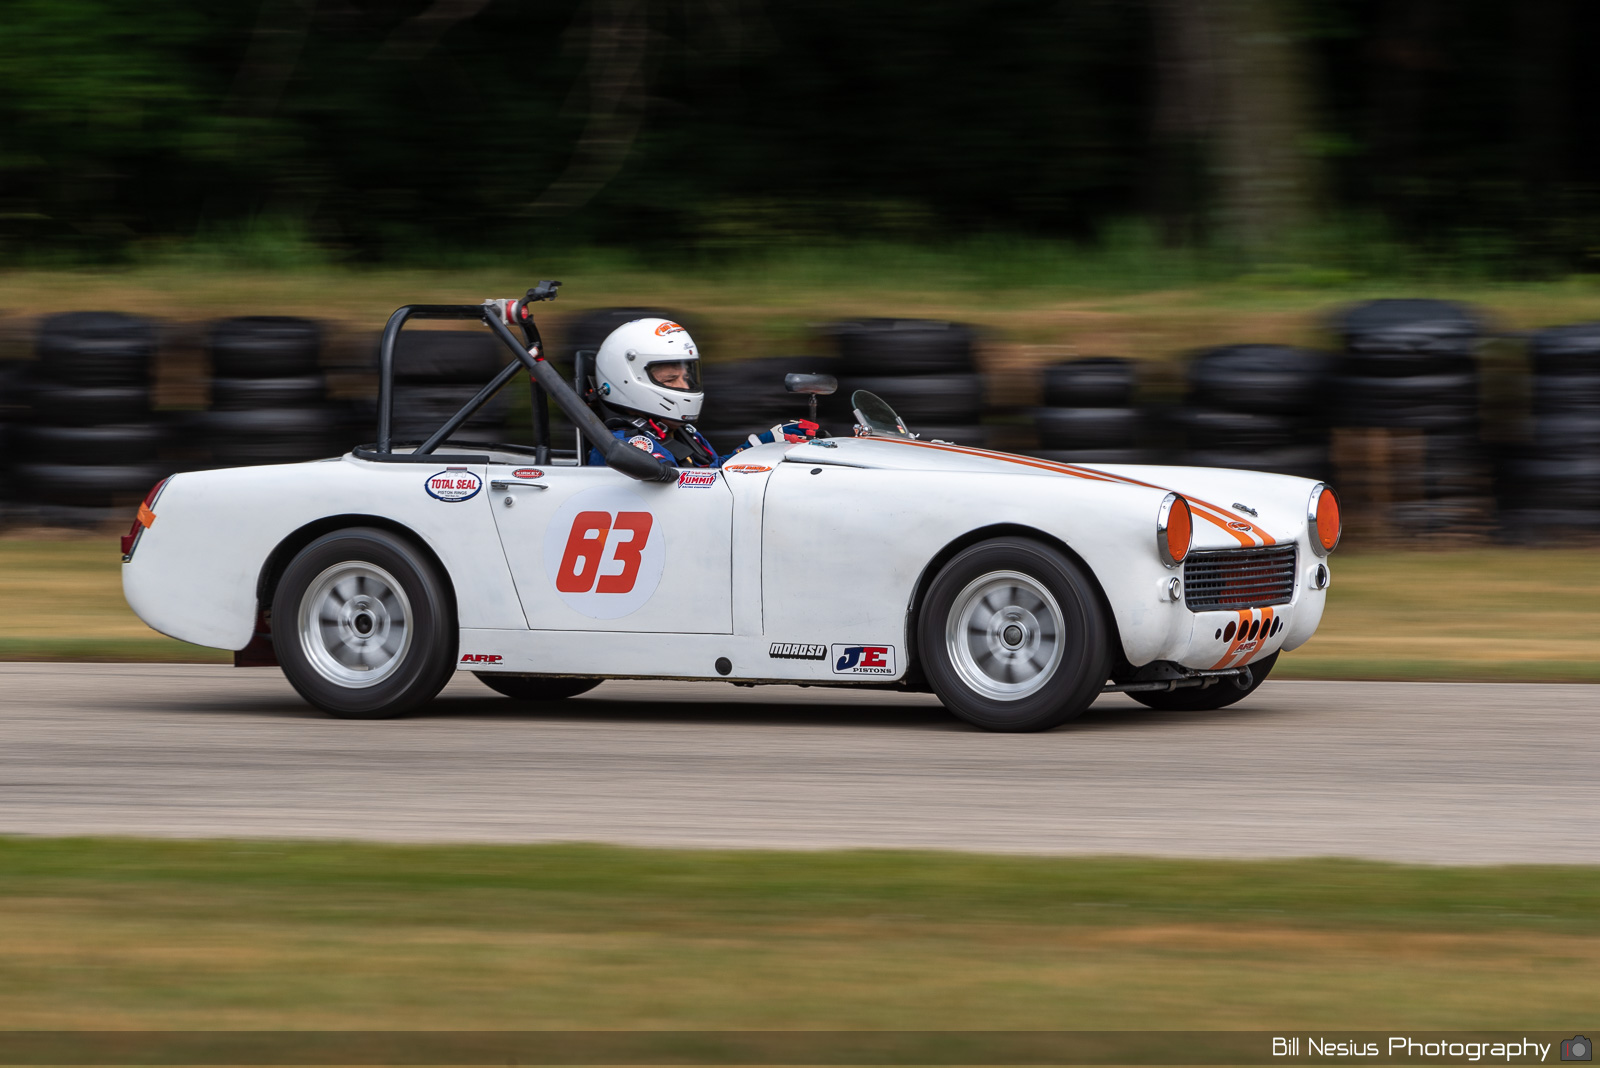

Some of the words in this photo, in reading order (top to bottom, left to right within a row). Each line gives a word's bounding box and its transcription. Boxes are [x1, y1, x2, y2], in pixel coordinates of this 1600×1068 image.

[431, 479, 455, 489] TOTAL
[456, 479, 477, 489] SEAL
[556, 511, 653, 594] 83
[461, 654, 503, 662] ARP
[769, 643, 827, 660] MOROSO
[836, 646, 889, 671] JE
